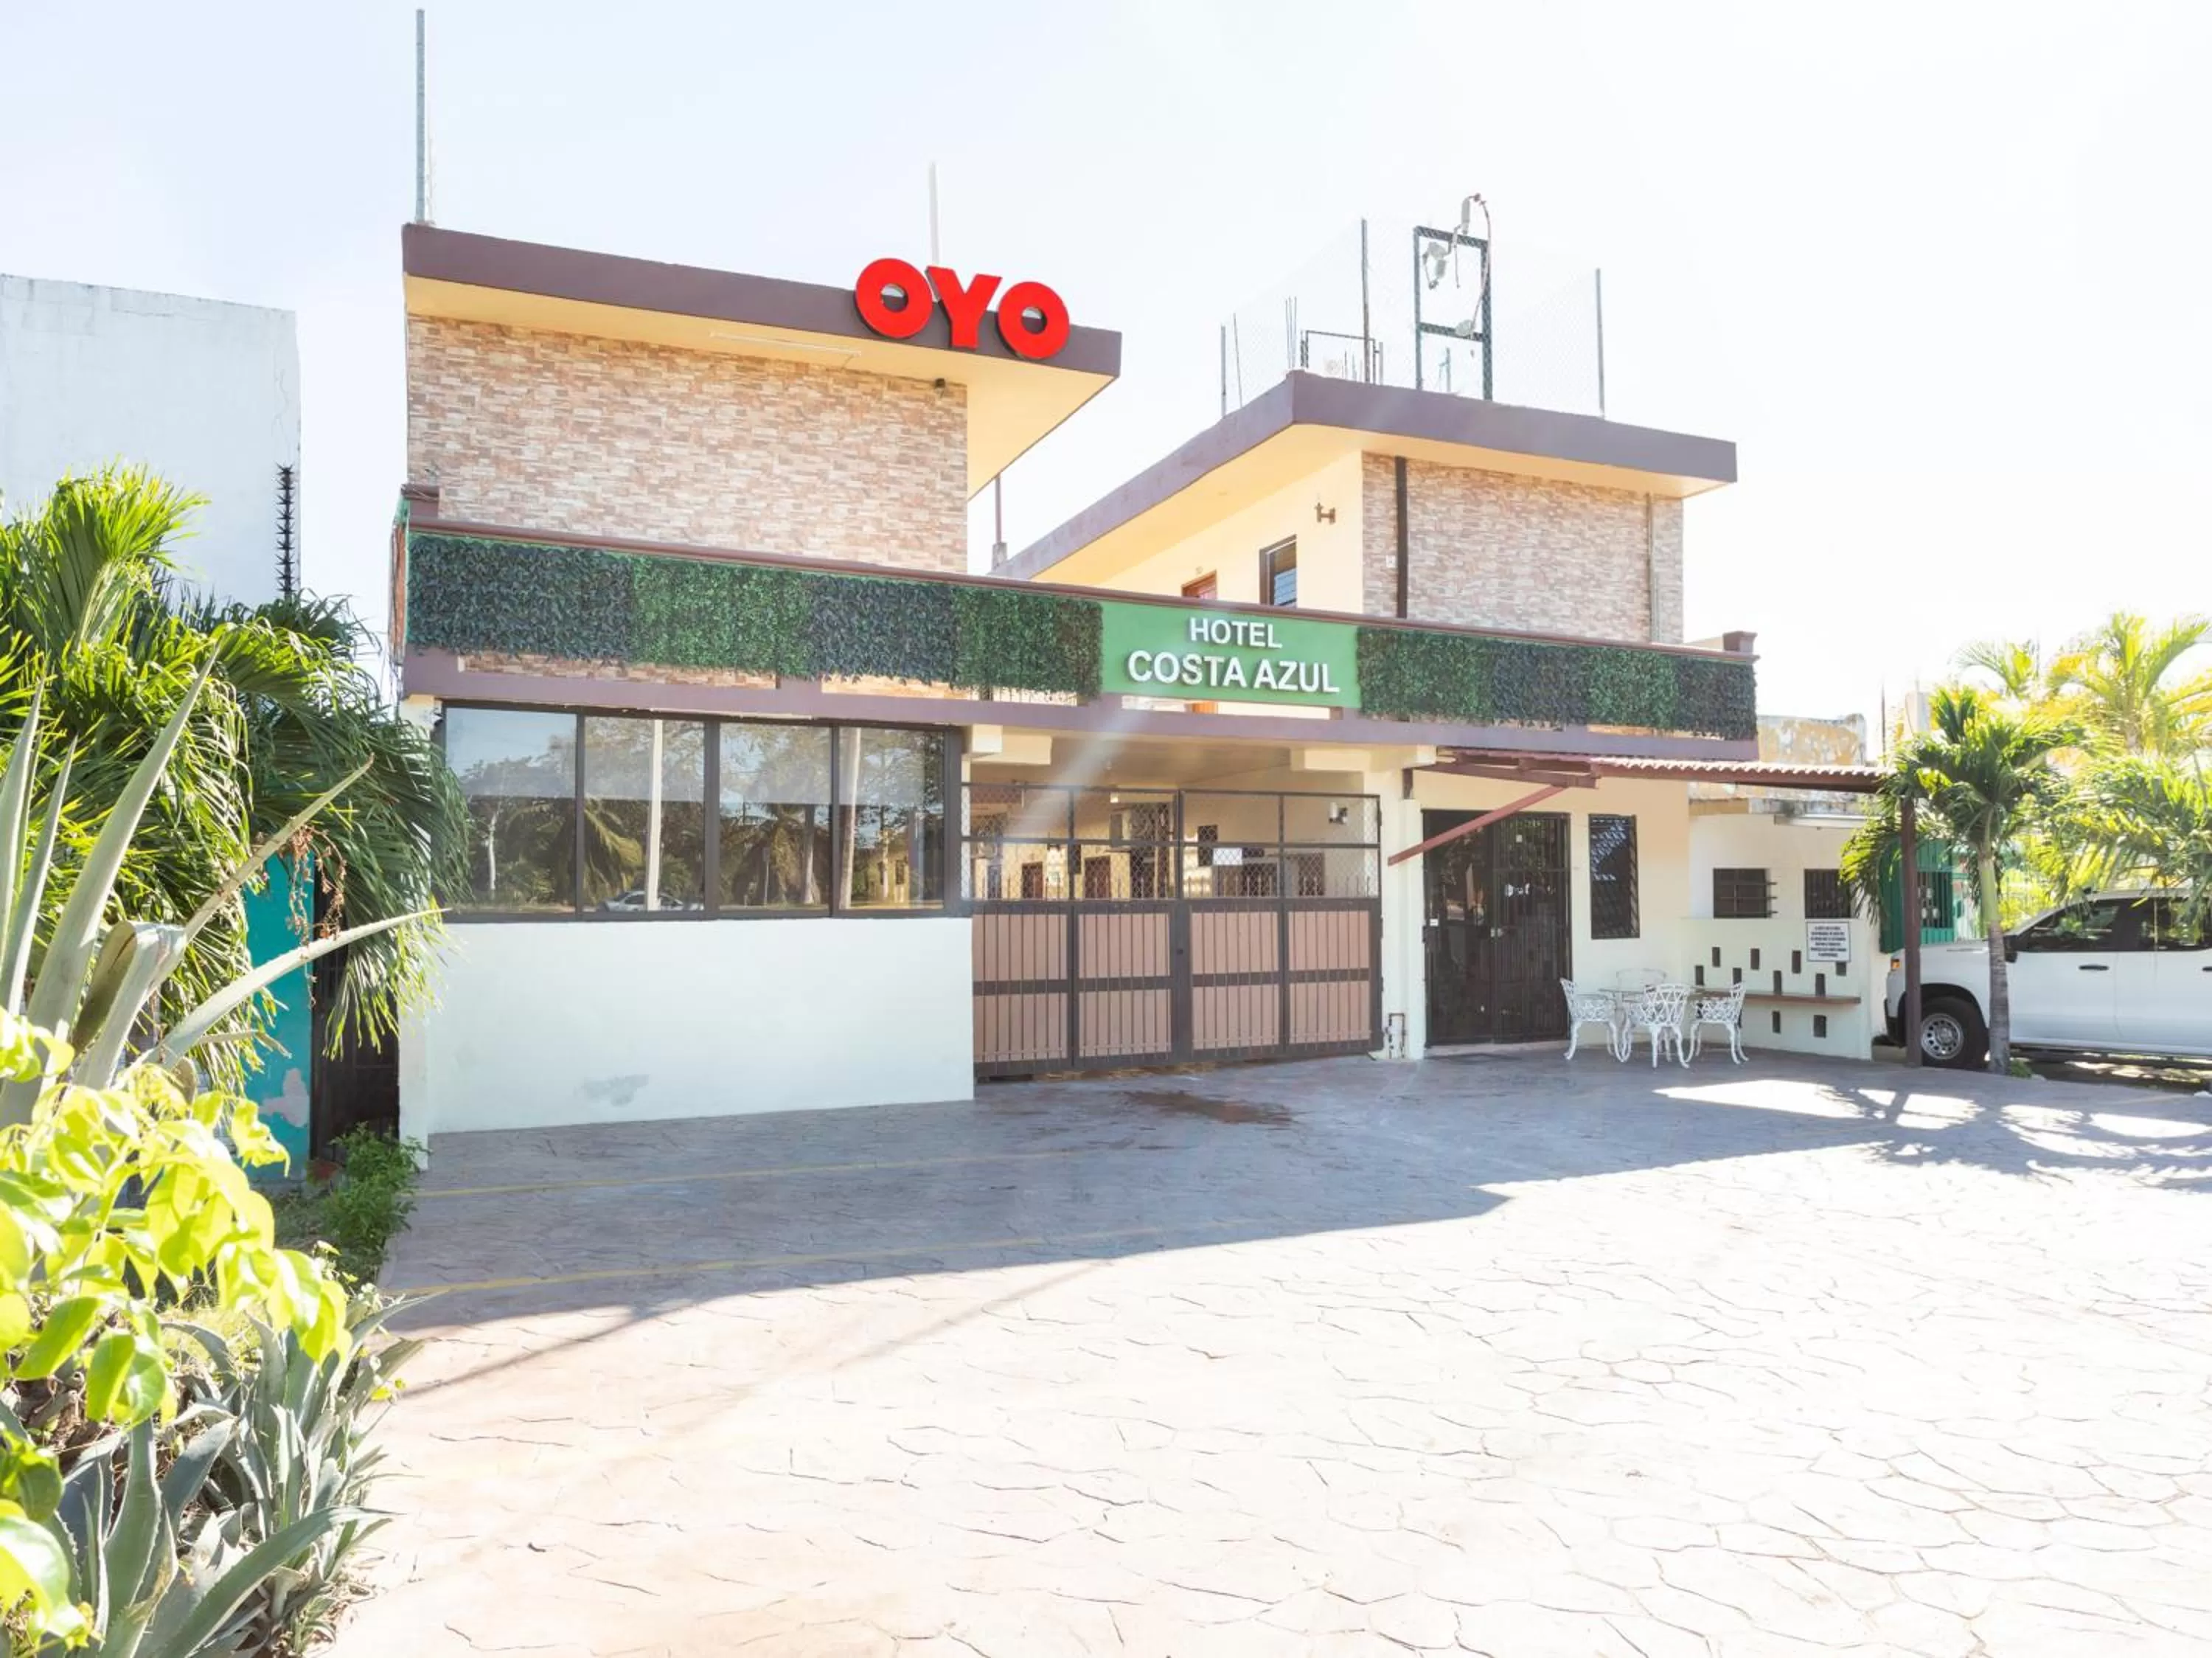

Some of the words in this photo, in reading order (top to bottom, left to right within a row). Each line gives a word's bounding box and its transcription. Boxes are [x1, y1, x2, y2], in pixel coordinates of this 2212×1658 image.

[855, 257, 1071, 360] OYO
[1189, 617, 1283, 648] HOTEL
[1127, 650, 1248, 687] COSTA
[1253, 658, 1340, 693] AZUL
